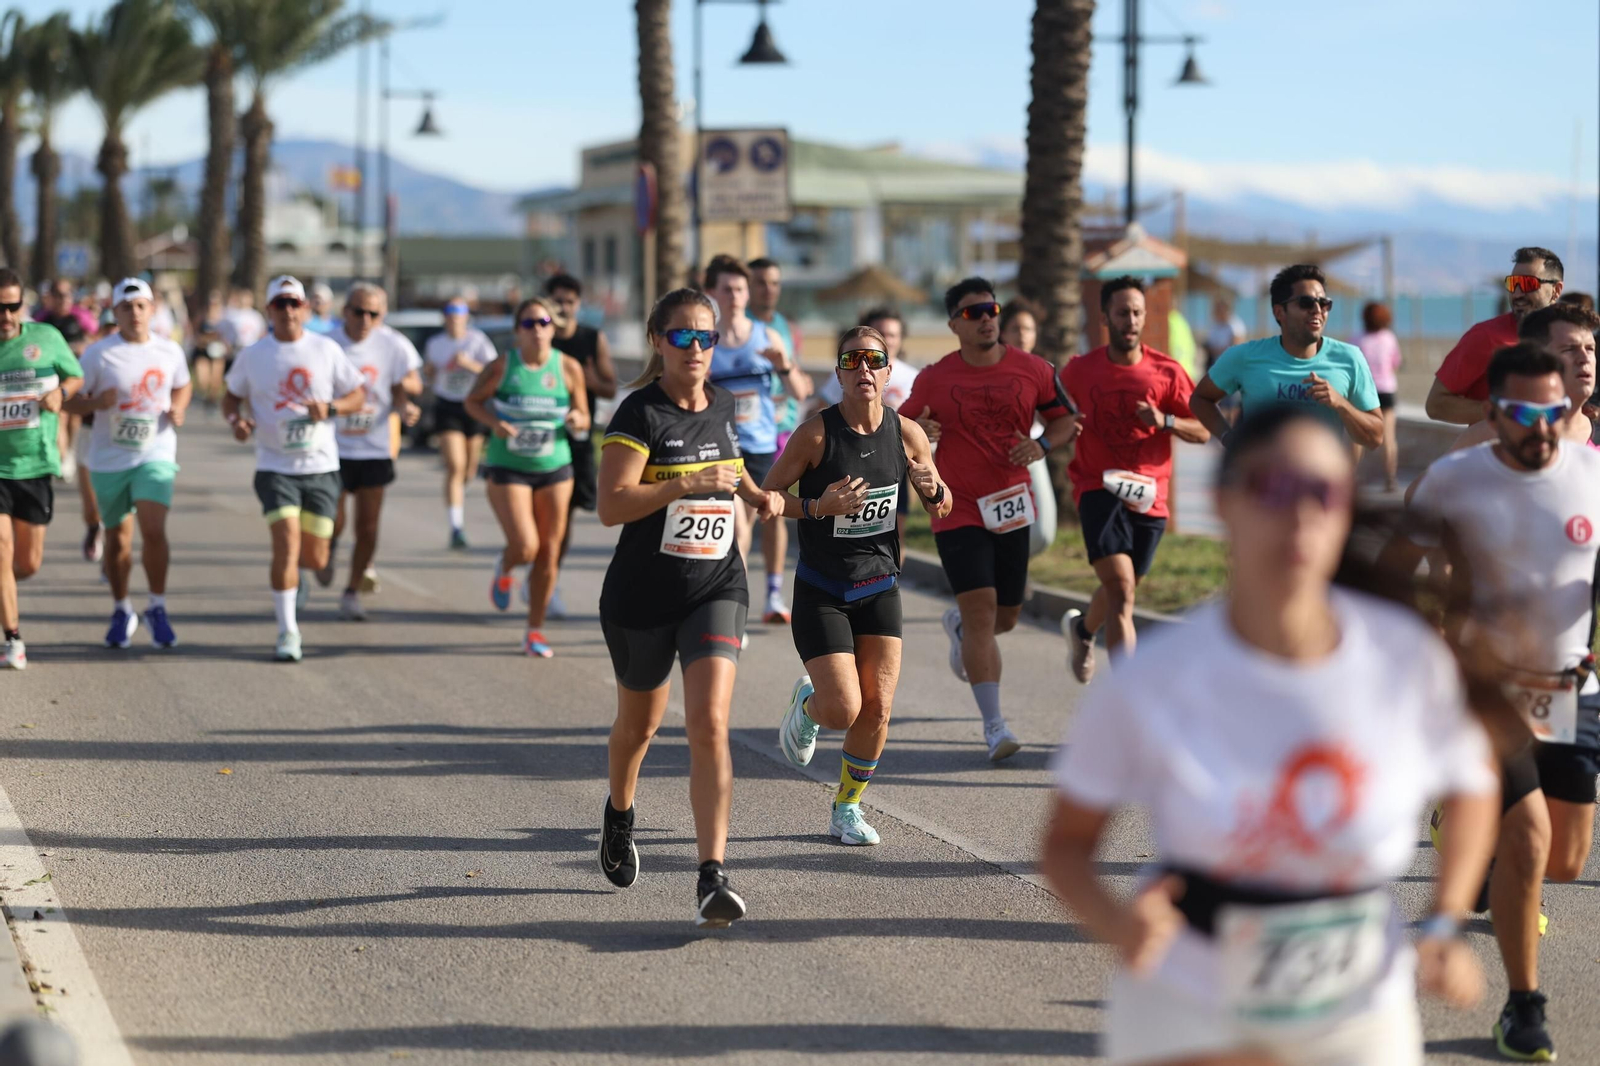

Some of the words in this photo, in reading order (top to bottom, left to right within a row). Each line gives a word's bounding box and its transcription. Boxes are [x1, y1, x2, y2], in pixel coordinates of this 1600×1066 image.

[2, 403, 31, 419] 105
[665, 440, 684, 448] vive
[1116, 481, 1145, 500] 114
[845, 498, 892, 523] 466
[993, 496, 1026, 522] 134
[674, 516, 726, 541] 296
